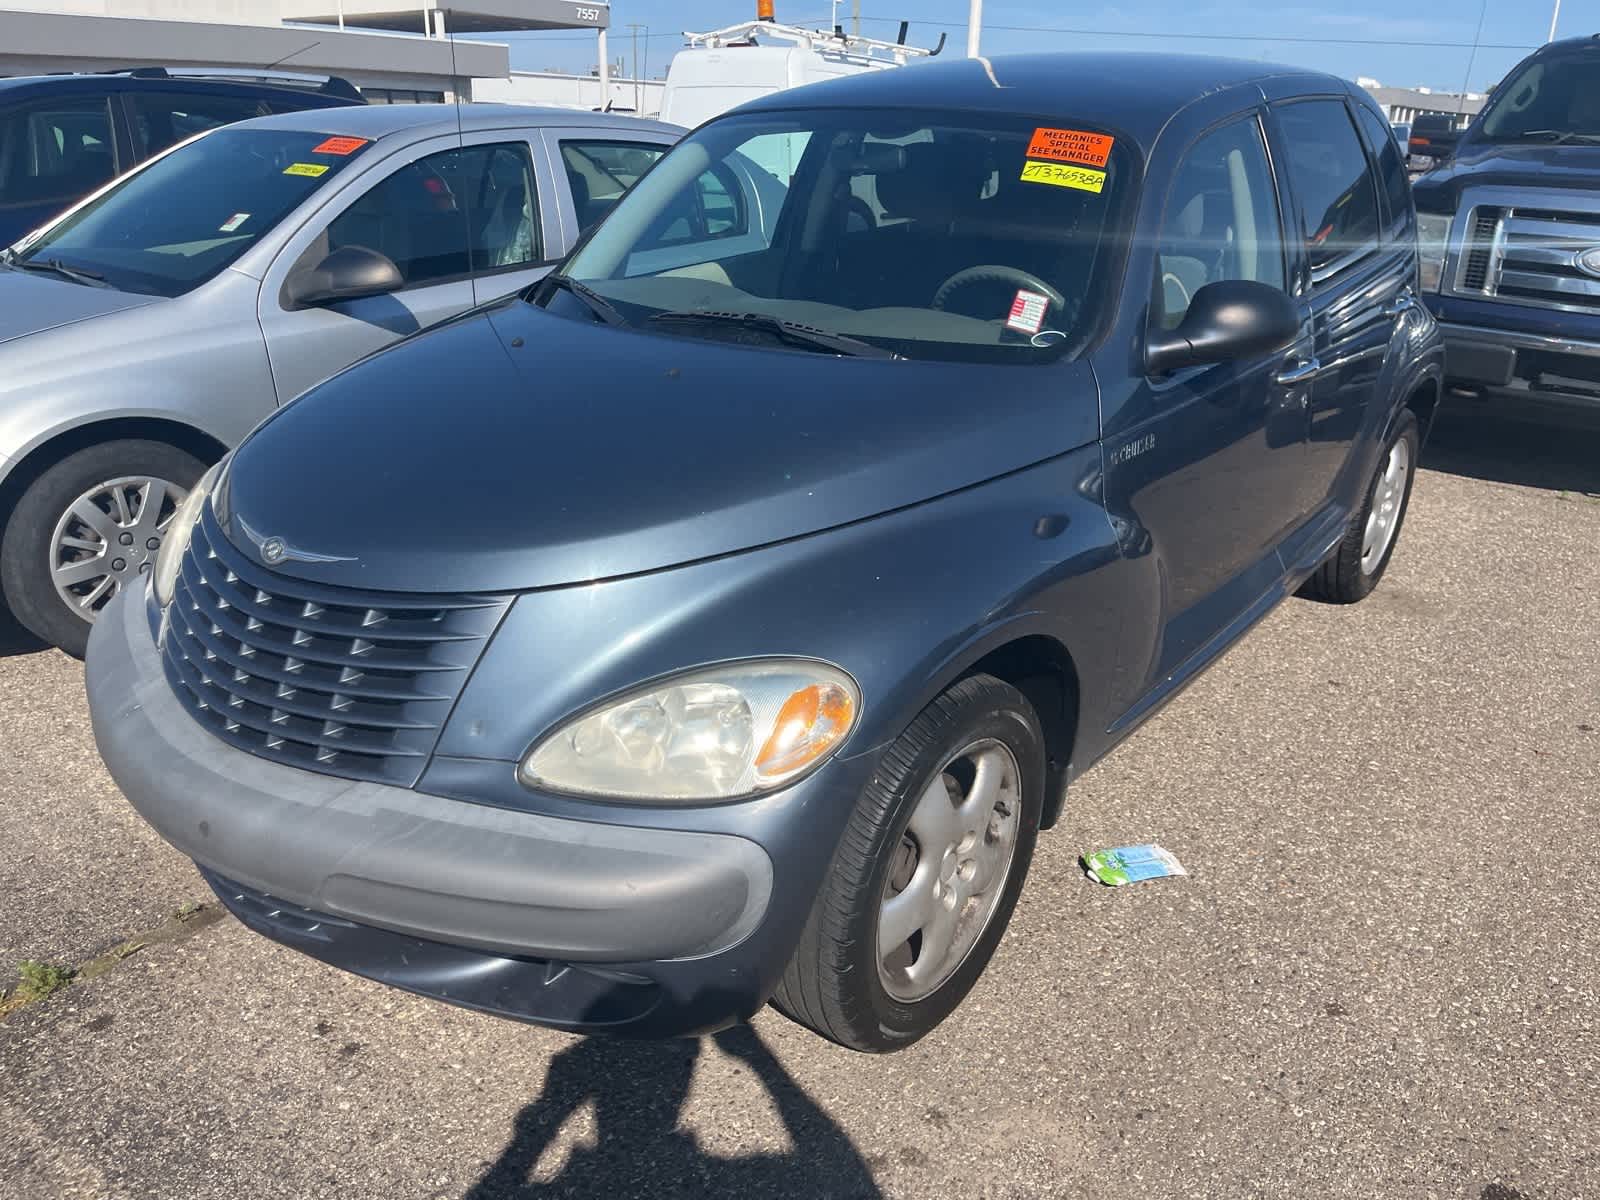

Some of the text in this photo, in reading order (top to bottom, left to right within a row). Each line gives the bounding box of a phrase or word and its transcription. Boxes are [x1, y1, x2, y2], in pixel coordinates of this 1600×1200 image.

[576, 7, 599, 20] 7557
[1043, 131, 1103, 144] MECHANICS
[1049, 140, 1090, 151] SPECIAL
[1031, 146, 1104, 162] SEE MANAGER
